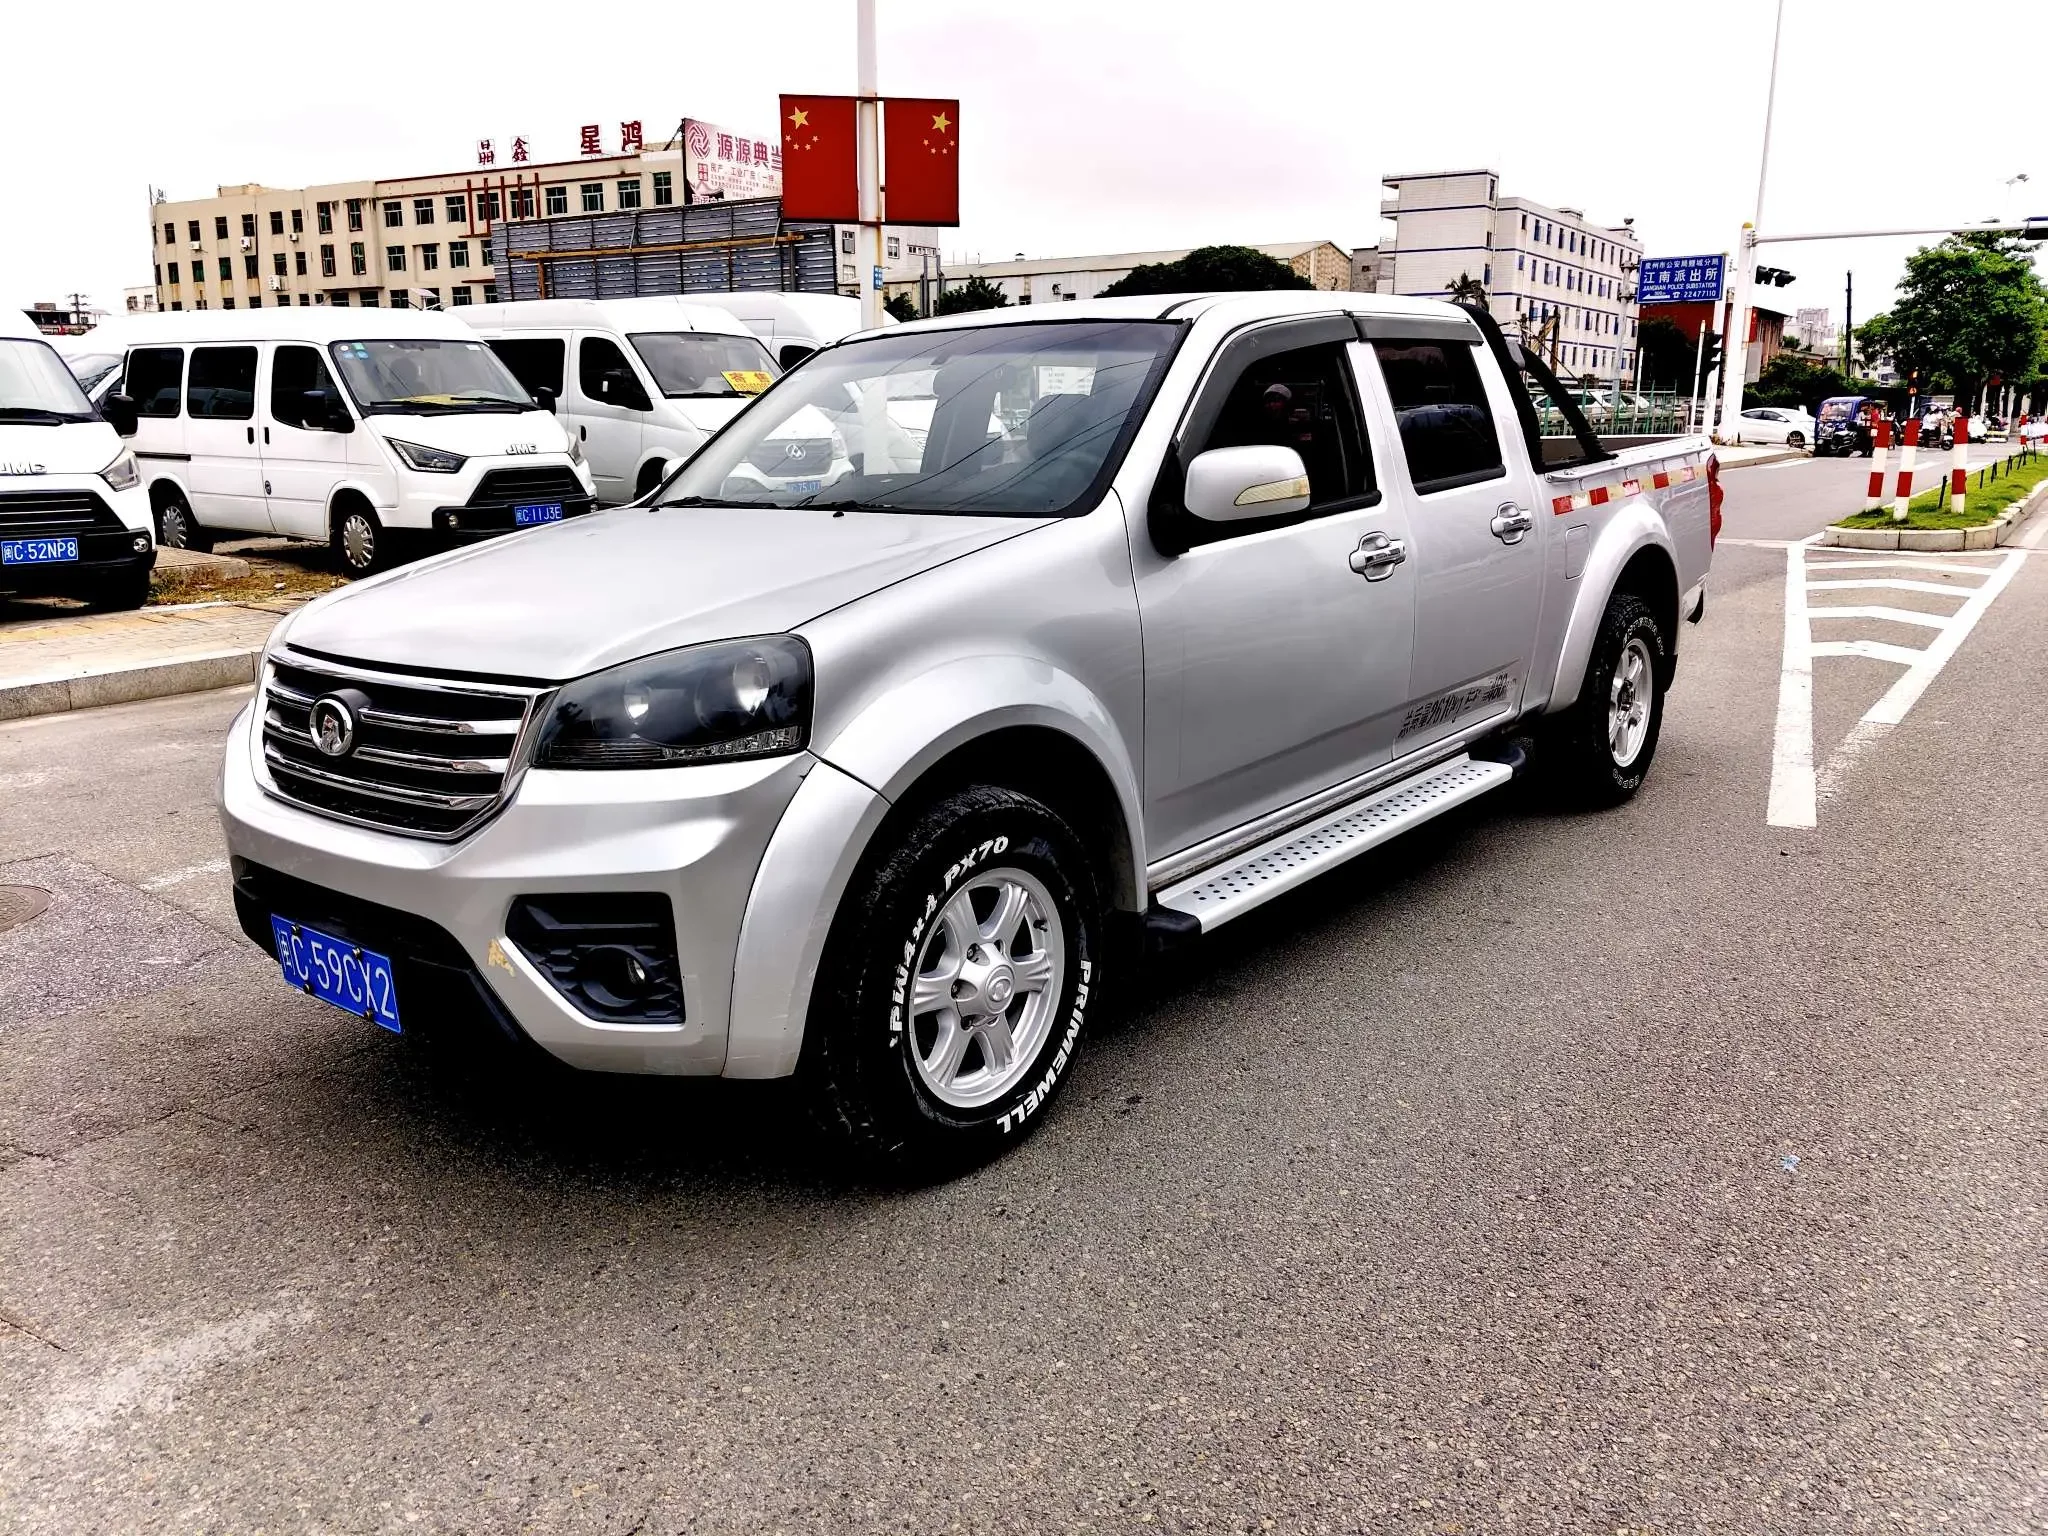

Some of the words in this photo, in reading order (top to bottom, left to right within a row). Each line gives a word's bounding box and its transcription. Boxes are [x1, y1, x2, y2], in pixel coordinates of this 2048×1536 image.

[1643, 268, 1718, 284] 江南派出所
[1684, 290, 1716, 298] 22477110
[943, 835, 1009, 892] PX70
[996, 959, 1092, 1134] PRIMEWELL
